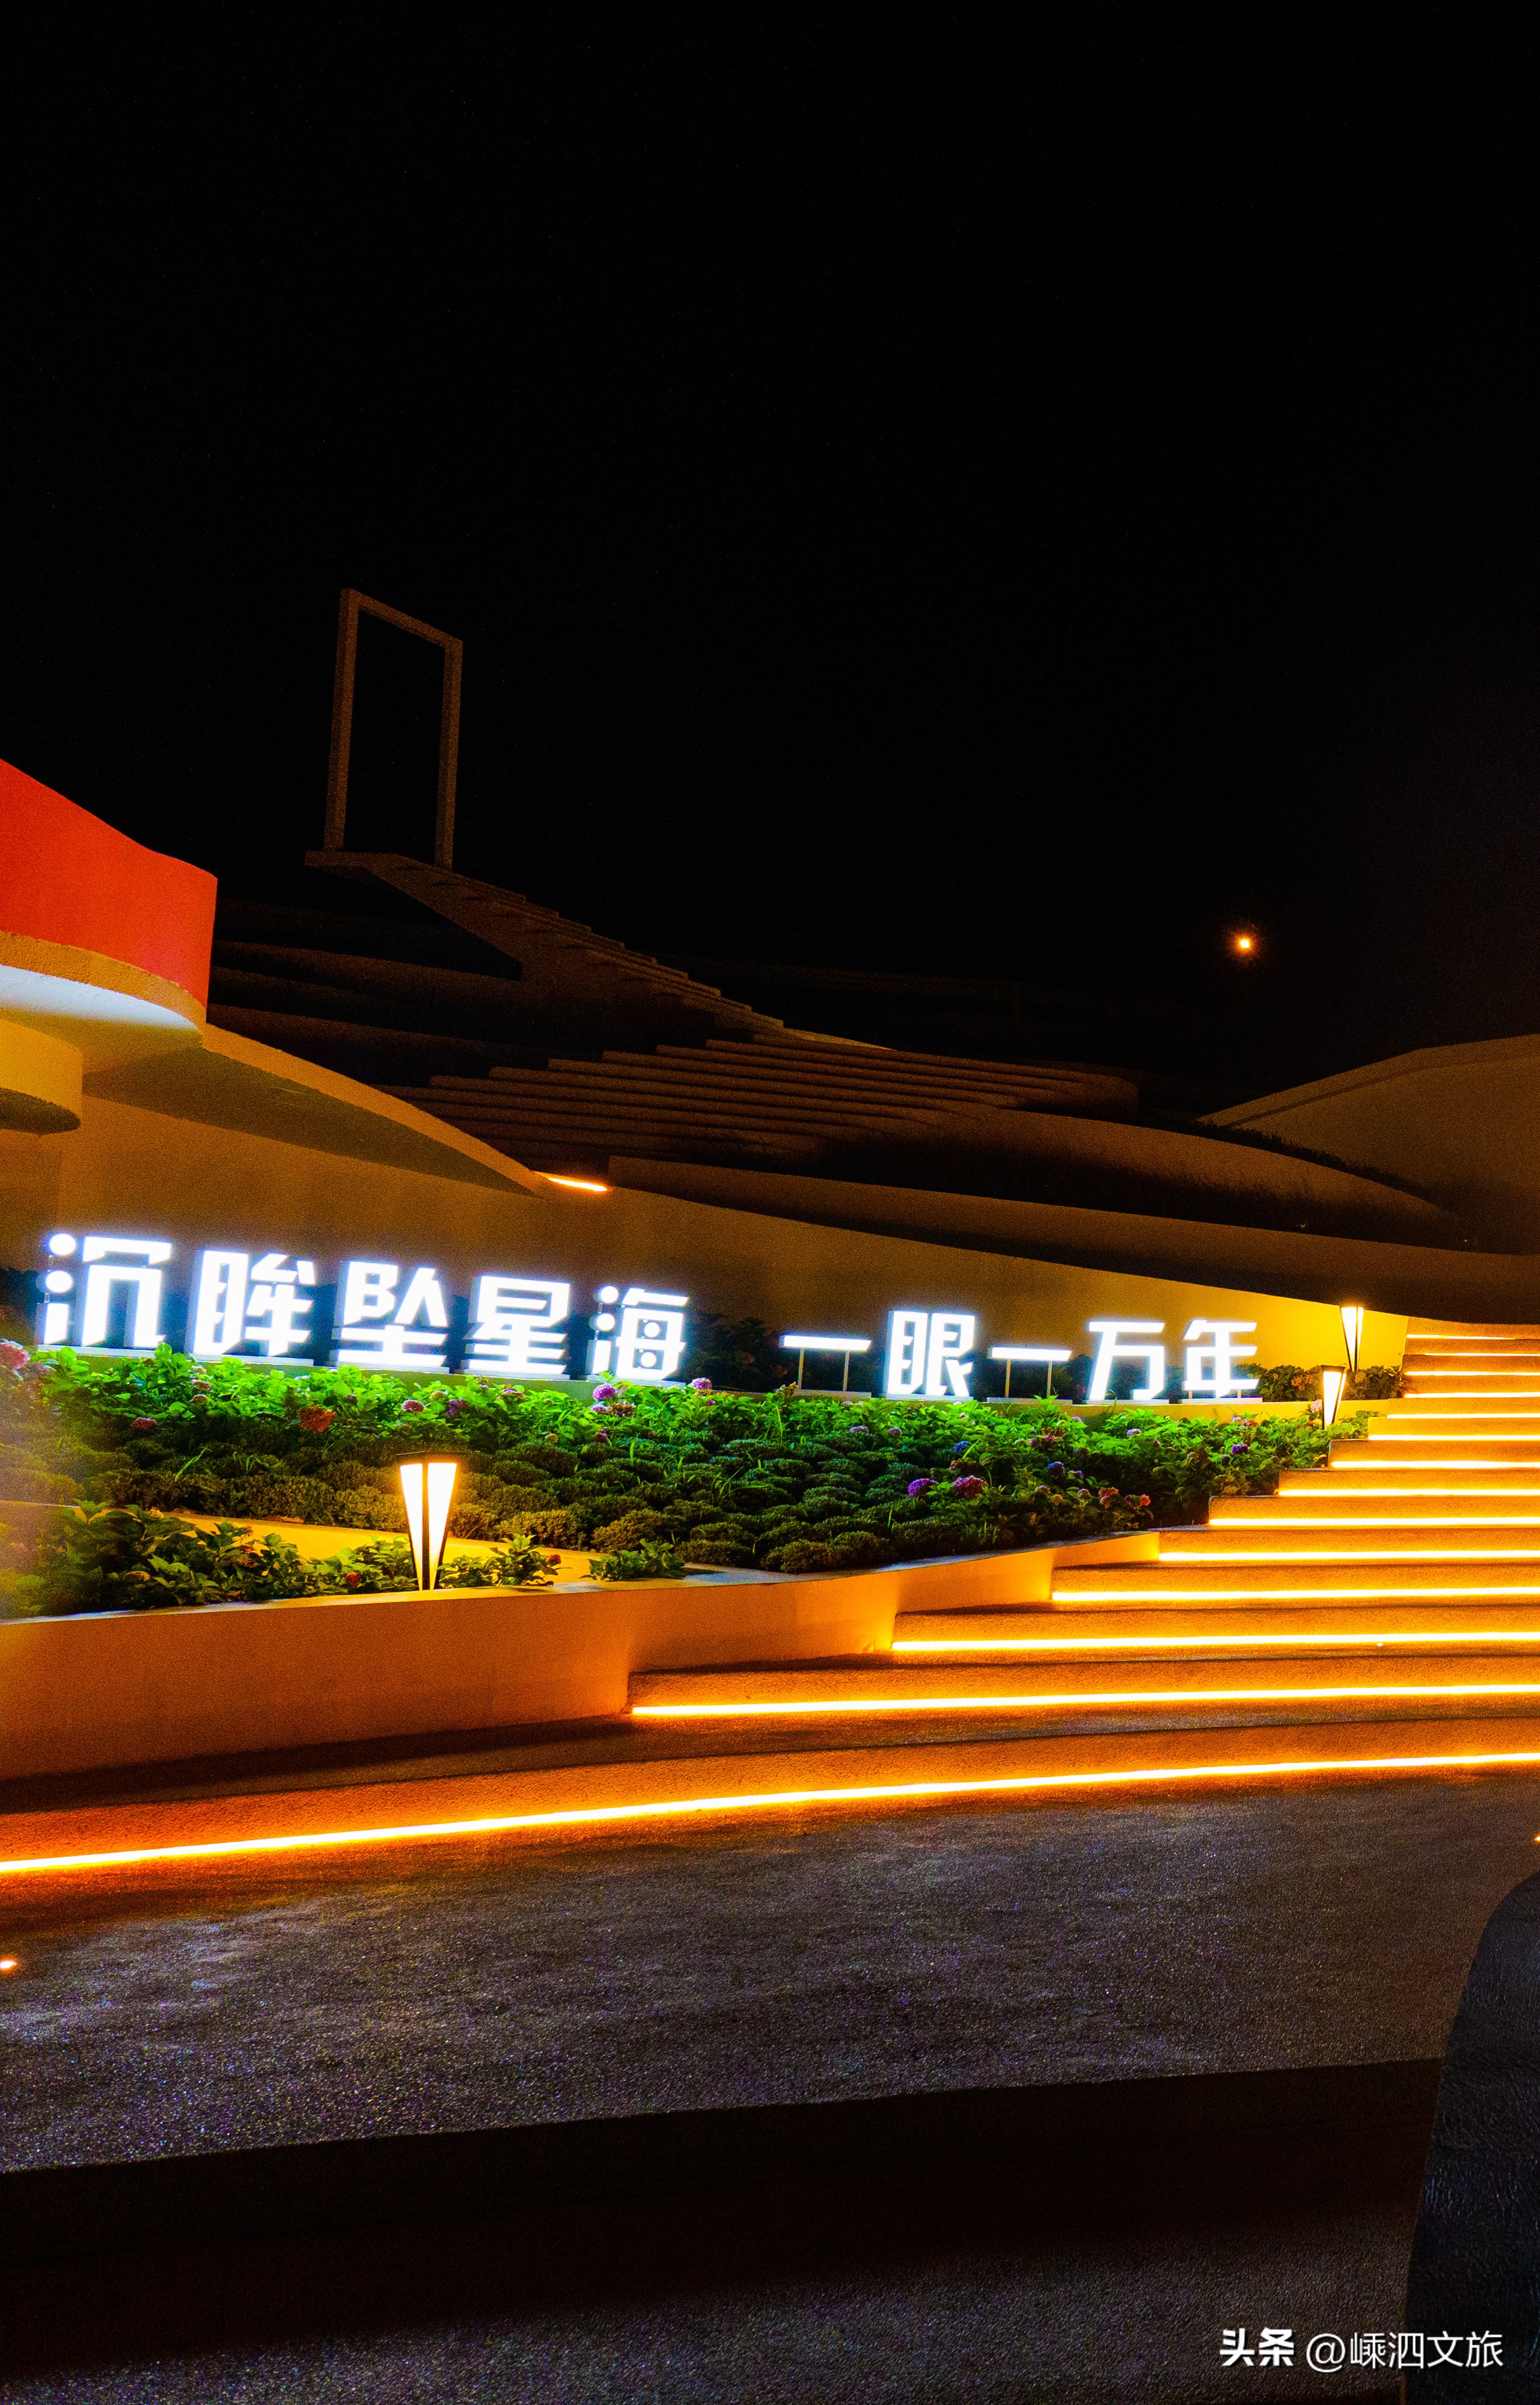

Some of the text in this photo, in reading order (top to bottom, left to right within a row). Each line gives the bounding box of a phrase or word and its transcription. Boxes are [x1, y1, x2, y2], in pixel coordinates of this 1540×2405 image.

[43, 1232, 1260, 1400] 沉眸坠星海 一眼一万年
